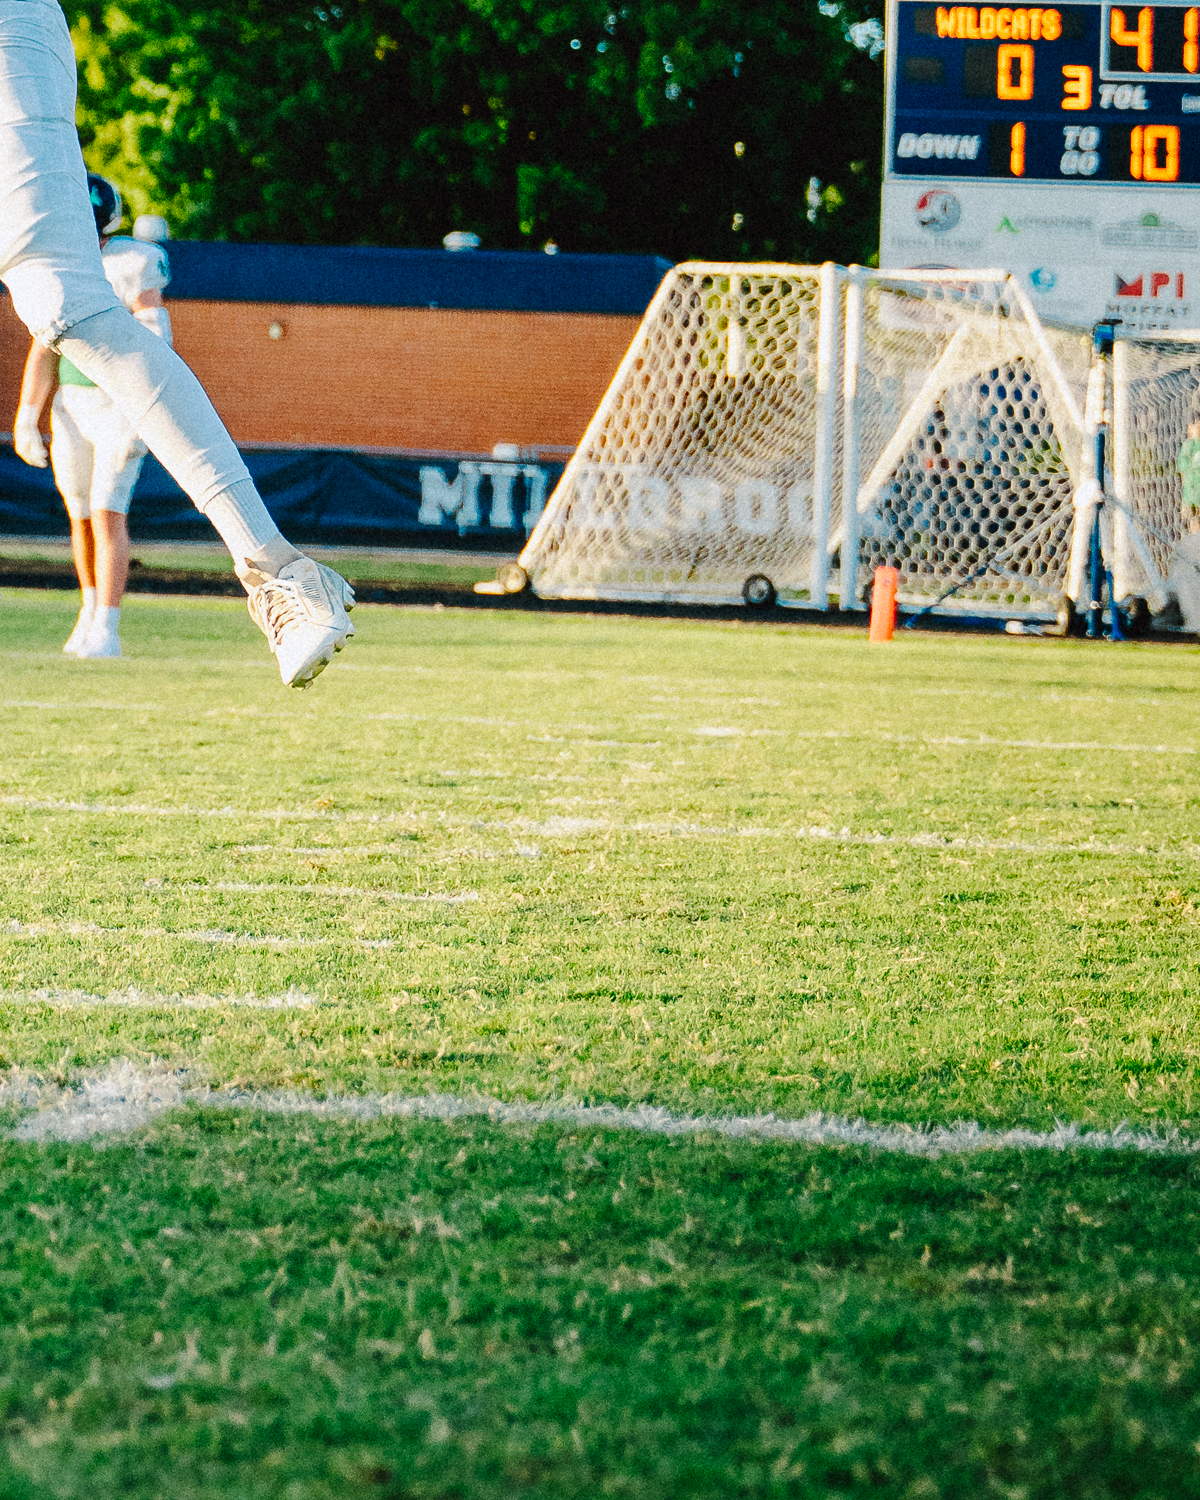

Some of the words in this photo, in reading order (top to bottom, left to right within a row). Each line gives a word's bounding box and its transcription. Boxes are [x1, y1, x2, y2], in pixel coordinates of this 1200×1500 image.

[936, 6, 1062, 40] WILDCATS
[997, 43, 1035, 100] 0
[1061, 64, 1093, 110] 3
[1098, 83, 1149, 110] TOL
[897, 132, 982, 160] DOWN
[1009, 121, 1026, 177] 1
[1062, 125, 1100, 150] TO
[1129, 124, 1181, 182] 10
